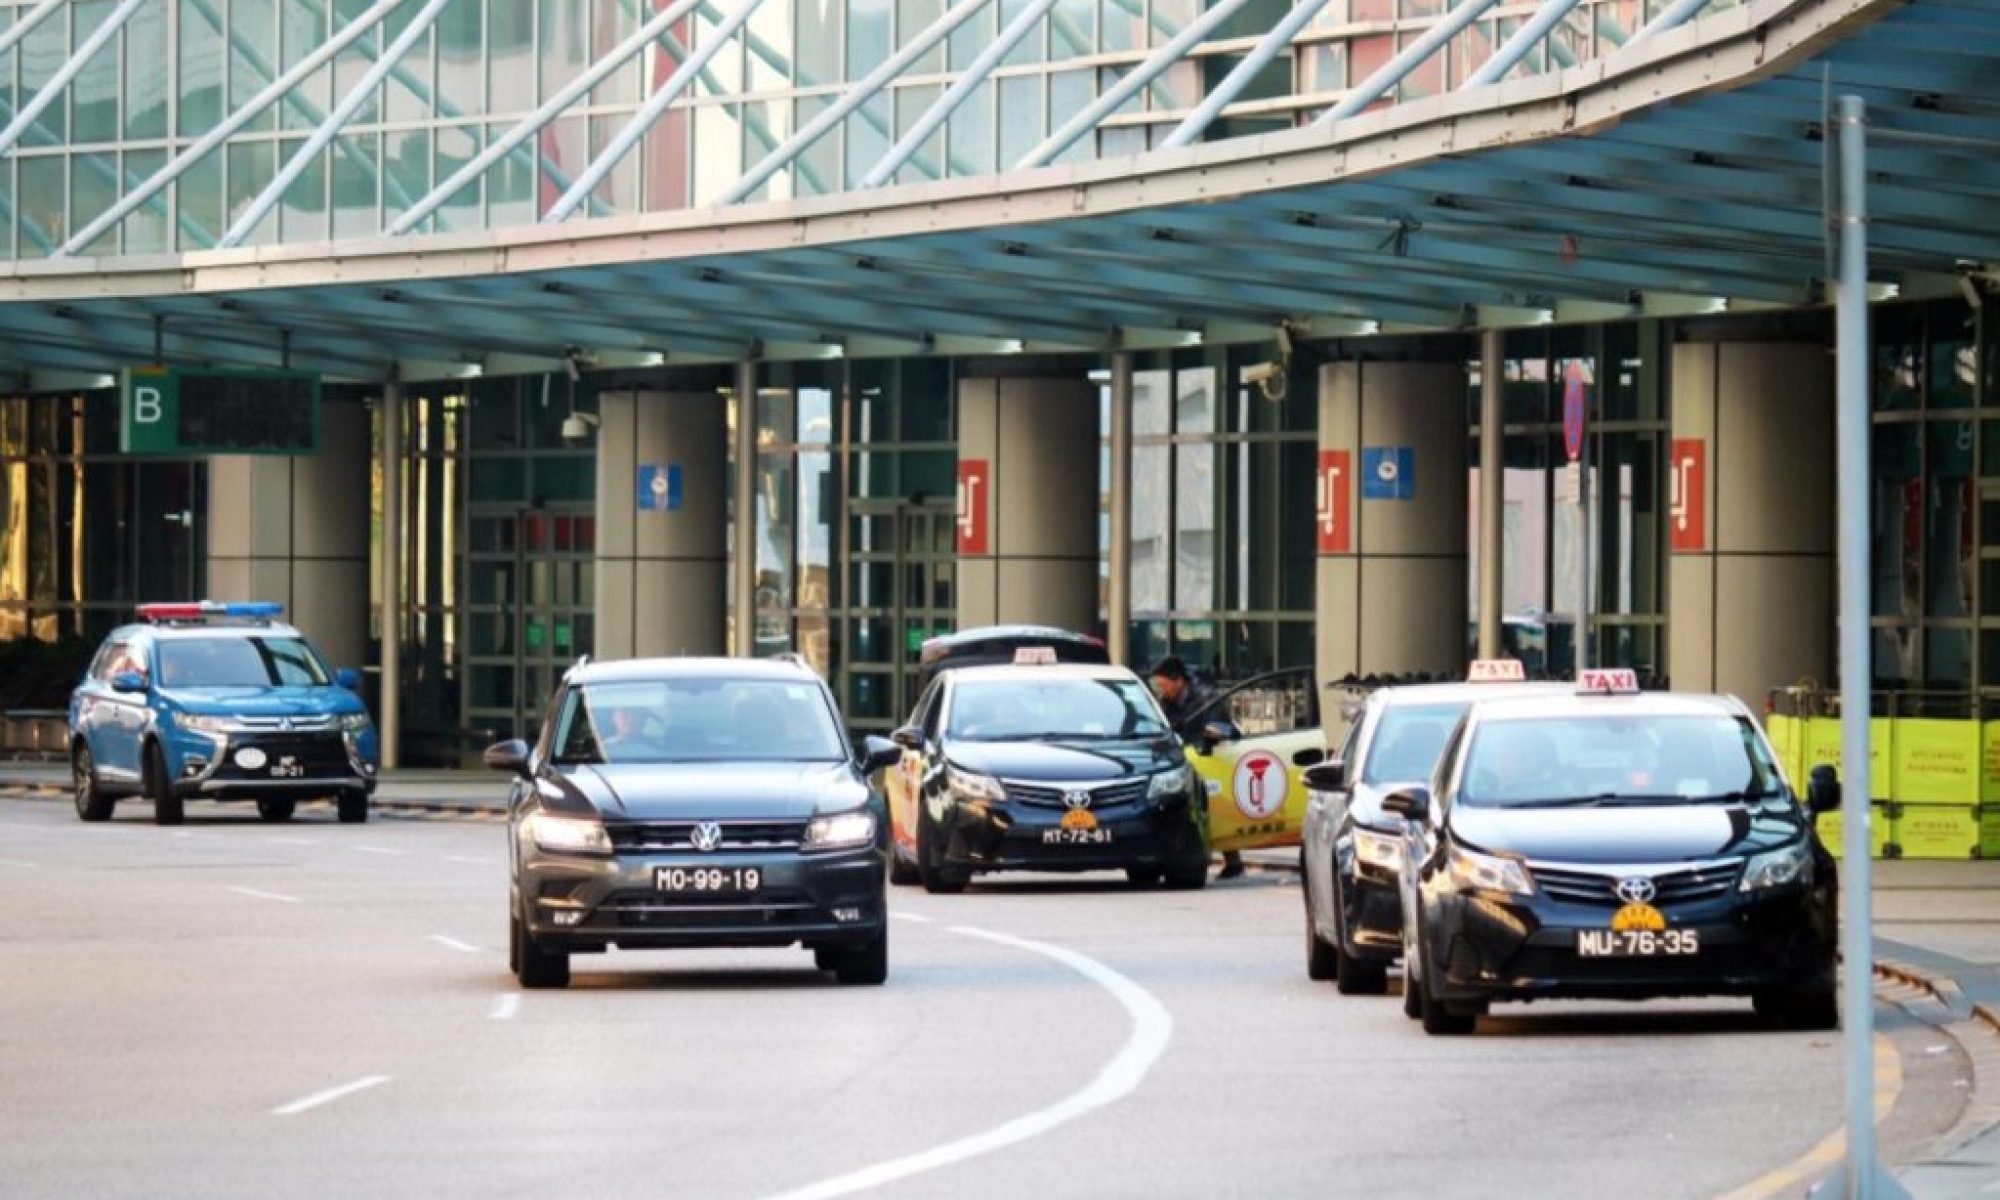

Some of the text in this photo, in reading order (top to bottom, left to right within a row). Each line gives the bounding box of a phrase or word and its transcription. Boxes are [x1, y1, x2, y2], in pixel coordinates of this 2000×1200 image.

[134, 386, 162, 423] B
[1476, 663, 1521, 677] TAXI
[1584, 672, 1632, 690] TAXI
[656, 869, 760, 890] MO-99-19
[1578, 929, 1698, 956] MU-76-35
